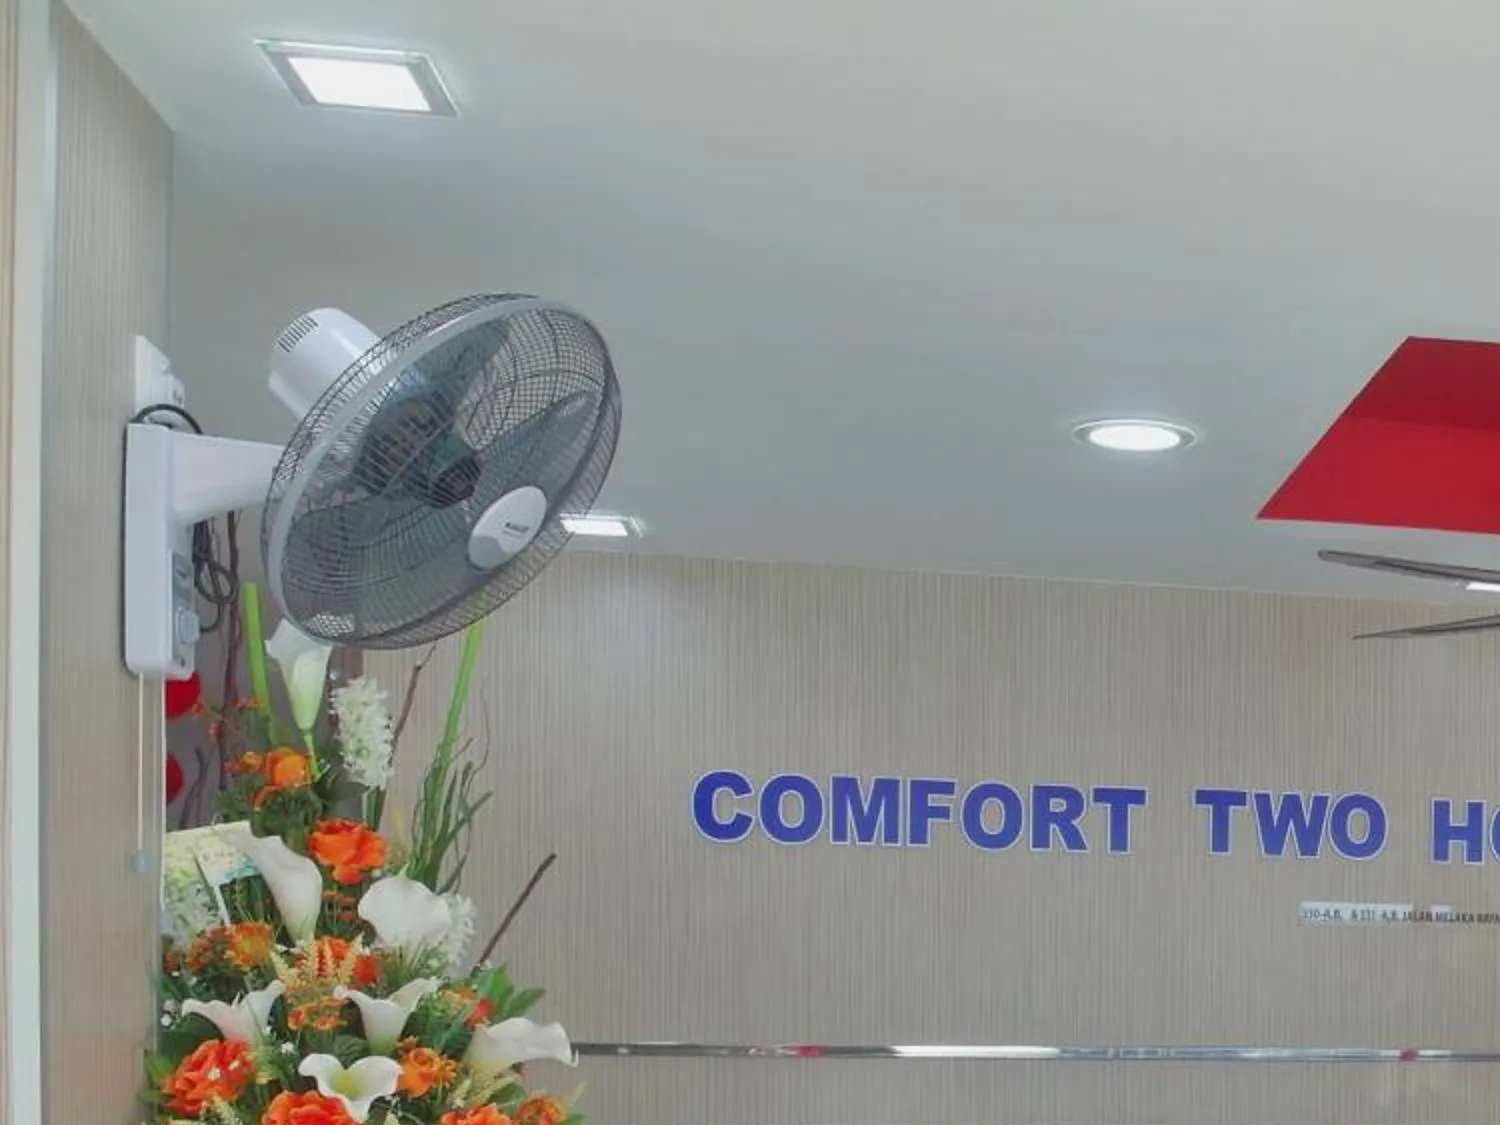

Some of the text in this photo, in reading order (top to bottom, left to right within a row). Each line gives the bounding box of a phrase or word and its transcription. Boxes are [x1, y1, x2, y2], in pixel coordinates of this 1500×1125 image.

[691, 770, 1148, 853] COMFORT
[1193, 788, 1387, 860] TWO
[1435, 911, 1475, 923] MELAKA
